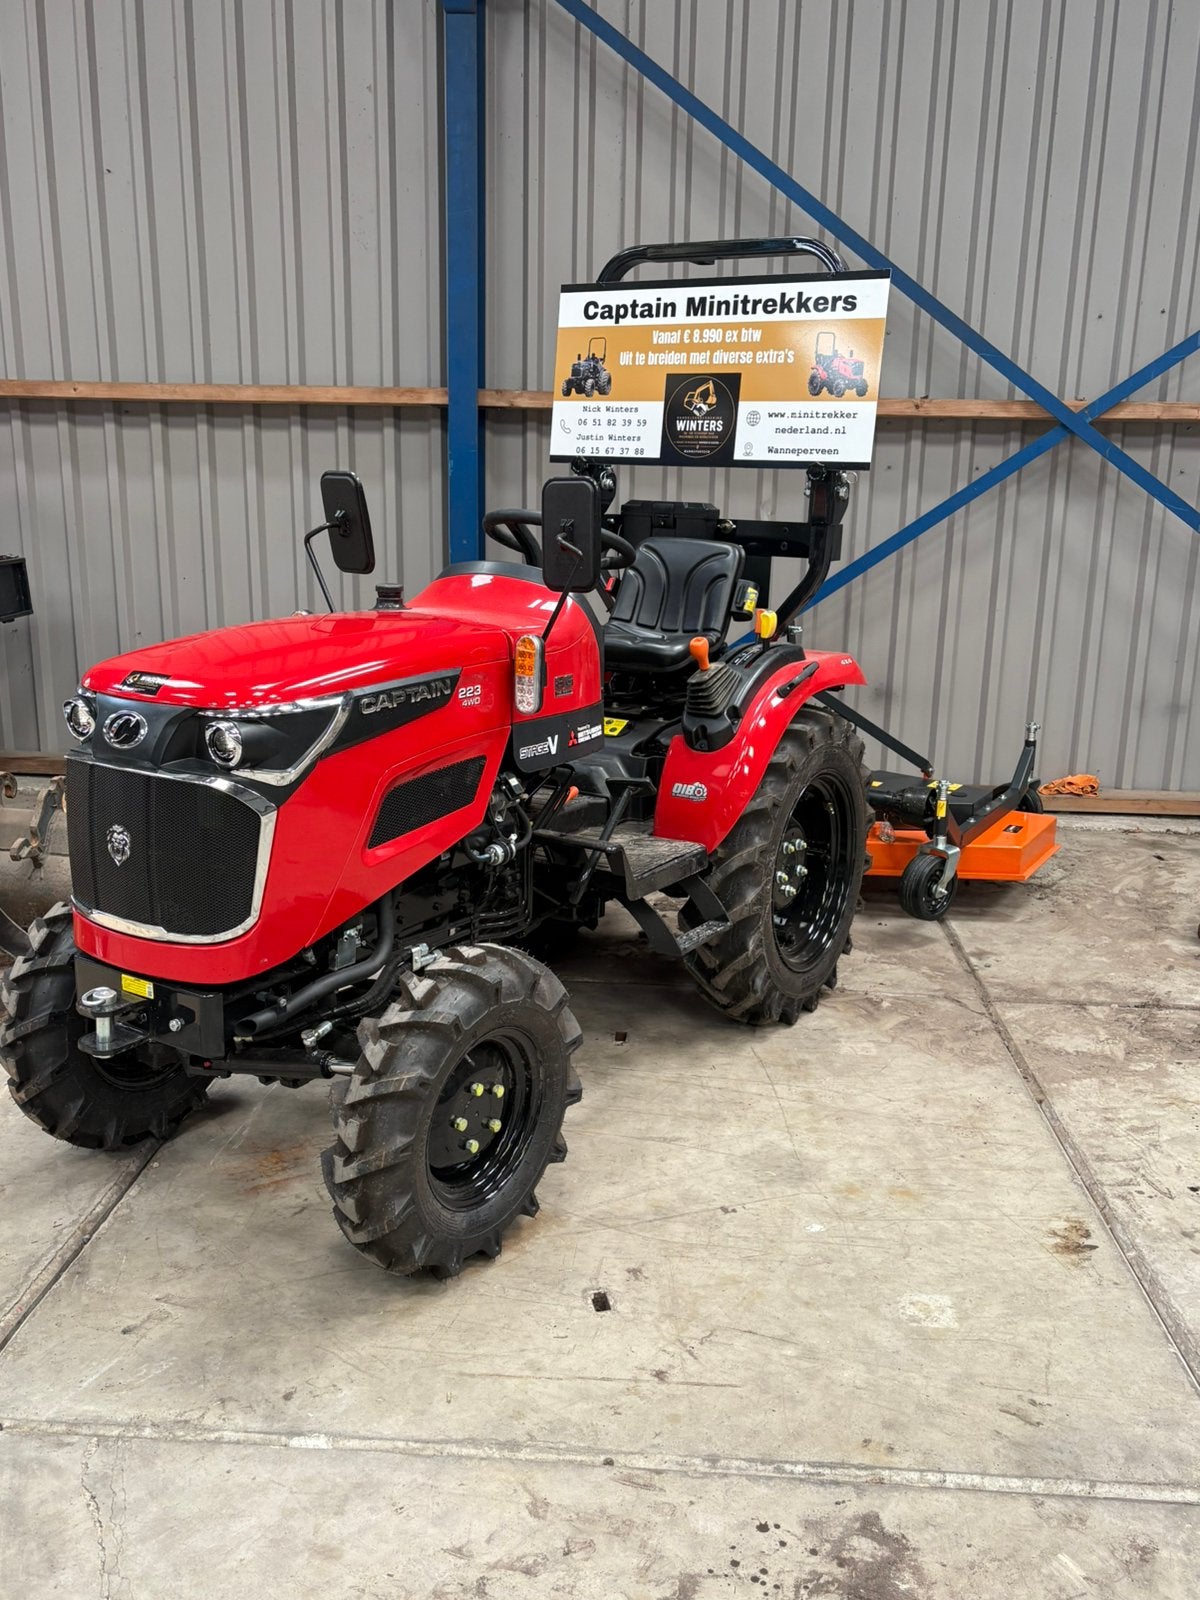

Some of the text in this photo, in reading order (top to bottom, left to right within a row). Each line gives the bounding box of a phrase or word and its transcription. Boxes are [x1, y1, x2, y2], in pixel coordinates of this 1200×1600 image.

[583, 292, 858, 324] Captain Minitrekkers
[652, 328, 762, 345] Vanaf € 8.990 ex btw
[619, 348, 795, 366] Uit te breiden met diverse extra's
[582, 405, 639, 413] Nick Winters
[767, 410, 858, 419] www.minitrekker
[578, 418, 647, 427] 06 51 82 39 59
[676, 419, 724, 432] WINTERS
[774, 426, 847, 435] nederland.nl
[576, 433, 641, 442] Justin Winters
[575, 446, 645, 455] 06 15 67 37 88
[767, 446, 839, 456] Wanneperveen
[360, 678, 451, 715] CAPTAIN
[458, 684, 481, 699] 223
[461, 696, 481, 708] 4WD
